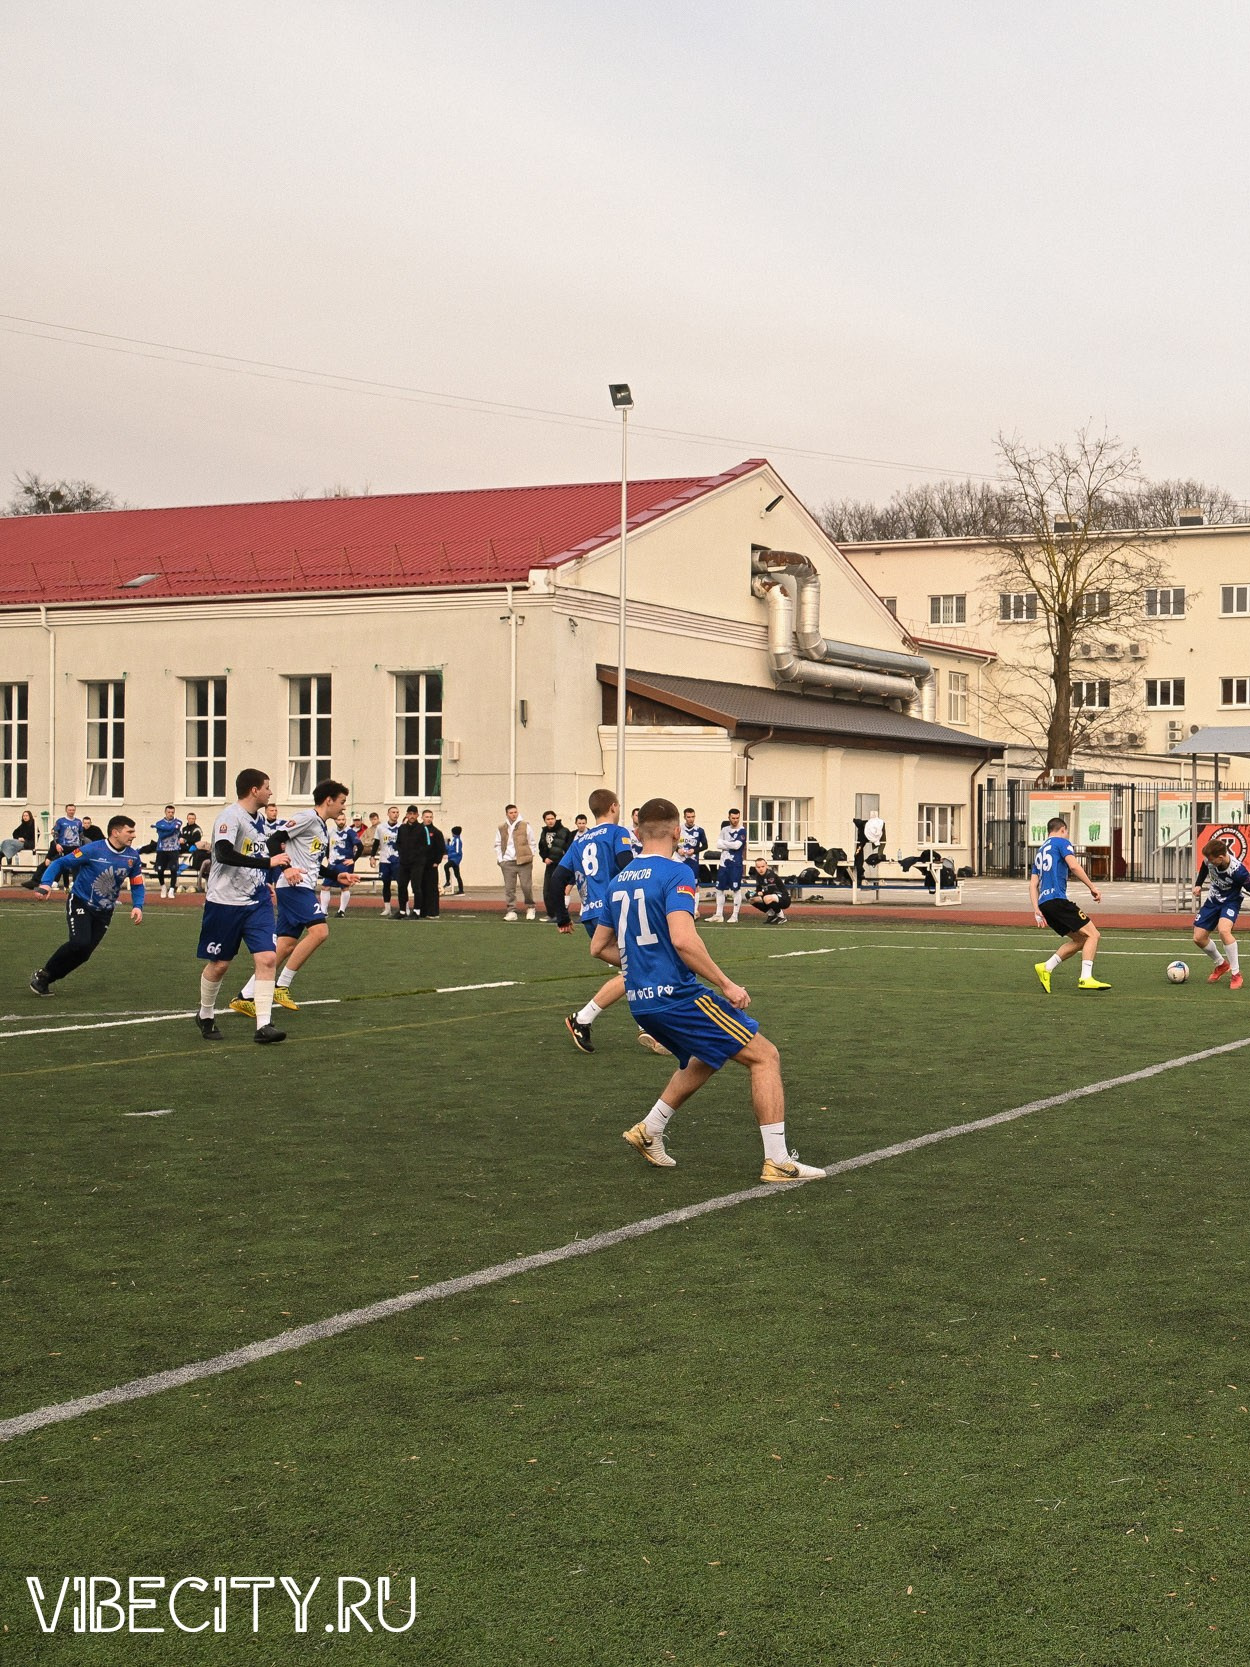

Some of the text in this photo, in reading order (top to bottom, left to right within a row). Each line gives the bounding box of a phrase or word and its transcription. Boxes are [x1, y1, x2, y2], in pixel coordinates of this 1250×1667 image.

[582, 842, 599, 877] 8
[1035, 845, 1053, 872] 95
[617, 868, 652, 883] БОРИСОВ
[612, 888, 659, 949] 71
[206, 941, 222, 955] 66
[637, 987, 654, 999] ФСБ
[657, 984, 674, 997] РФ
